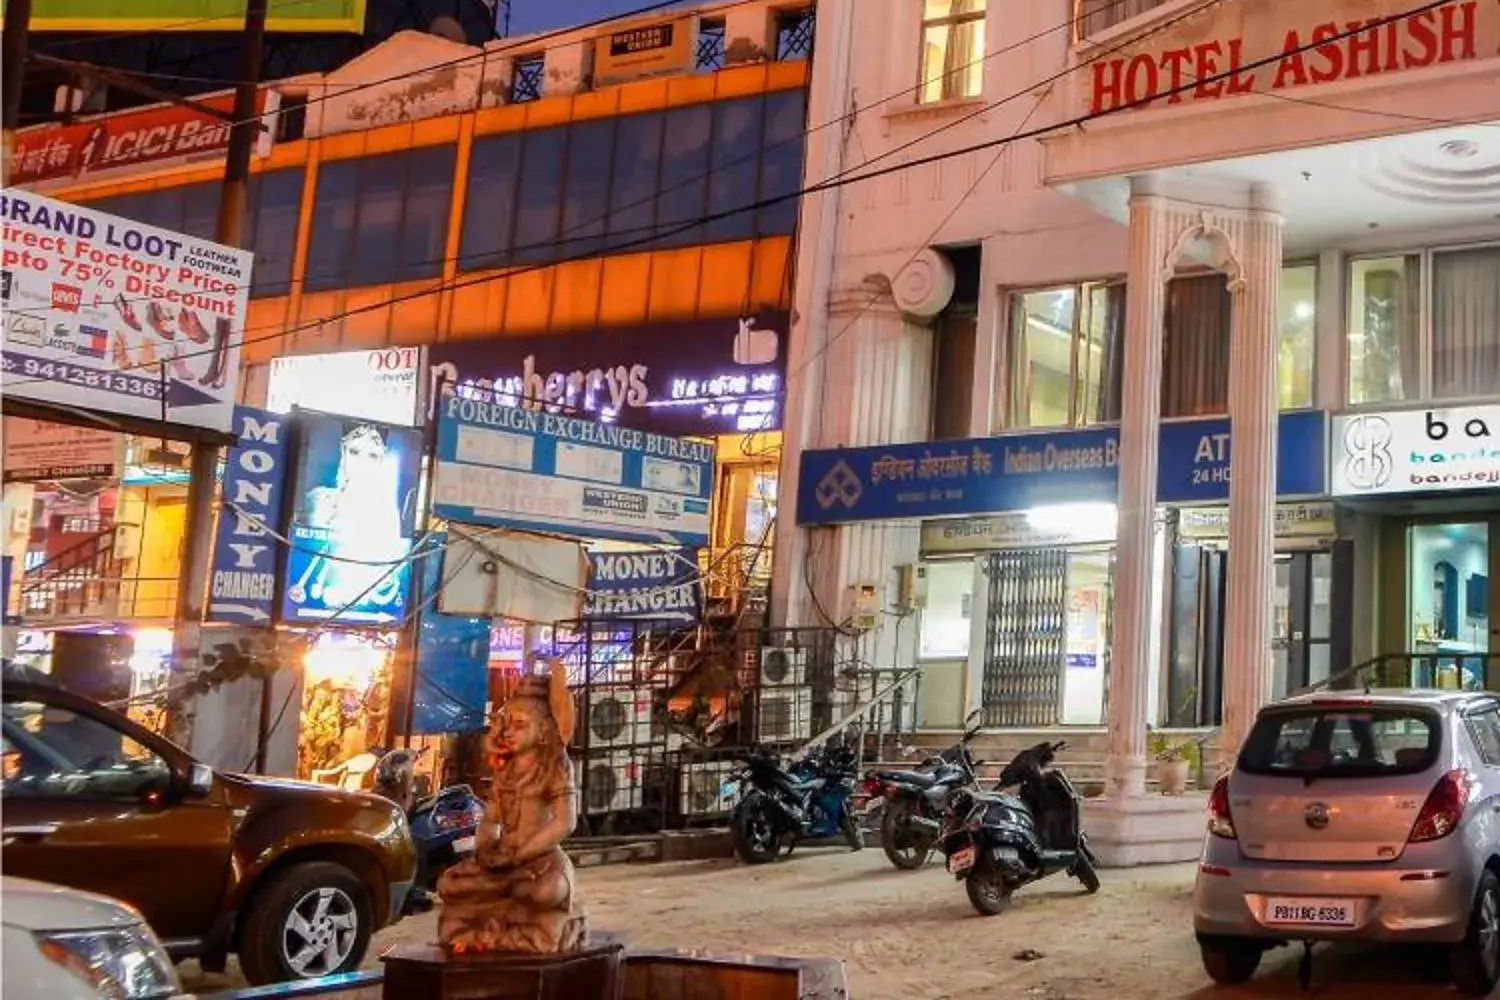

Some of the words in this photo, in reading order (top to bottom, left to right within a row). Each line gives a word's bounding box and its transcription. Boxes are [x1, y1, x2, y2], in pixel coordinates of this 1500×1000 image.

[1091, 37, 1254, 116] HOTEL
[1273, 1, 1477, 89] ASHISH
[177, 119, 232, 149] Ban
[106, 224, 182, 261] LOOT
[189, 247, 238, 265] LEATHER
[2, 222, 67, 254] irect
[177, 266, 238, 295] Price
[183, 256, 242, 278] FOOTWEAR
[2, 248, 48, 271] pto
[60, 258, 115, 289] 75%
[124, 274, 236, 316] Discount
[448, 398, 540, 433] FOREIGN
[544, 413, 642, 451] EXCHANGE
[647, 431, 712, 463] BUREAU
[1005, 447, 1043, 475] Indian
[1045, 443, 1104, 471] Overseas
[1194, 433, 1232, 464] AT
[229, 417, 280, 567] MONEY
[1192, 469, 1211, 484] 24
[596, 553, 678, 581] MONEY
[213, 570, 275, 599] CHANGER
[584, 584, 696, 615] CHANGER
